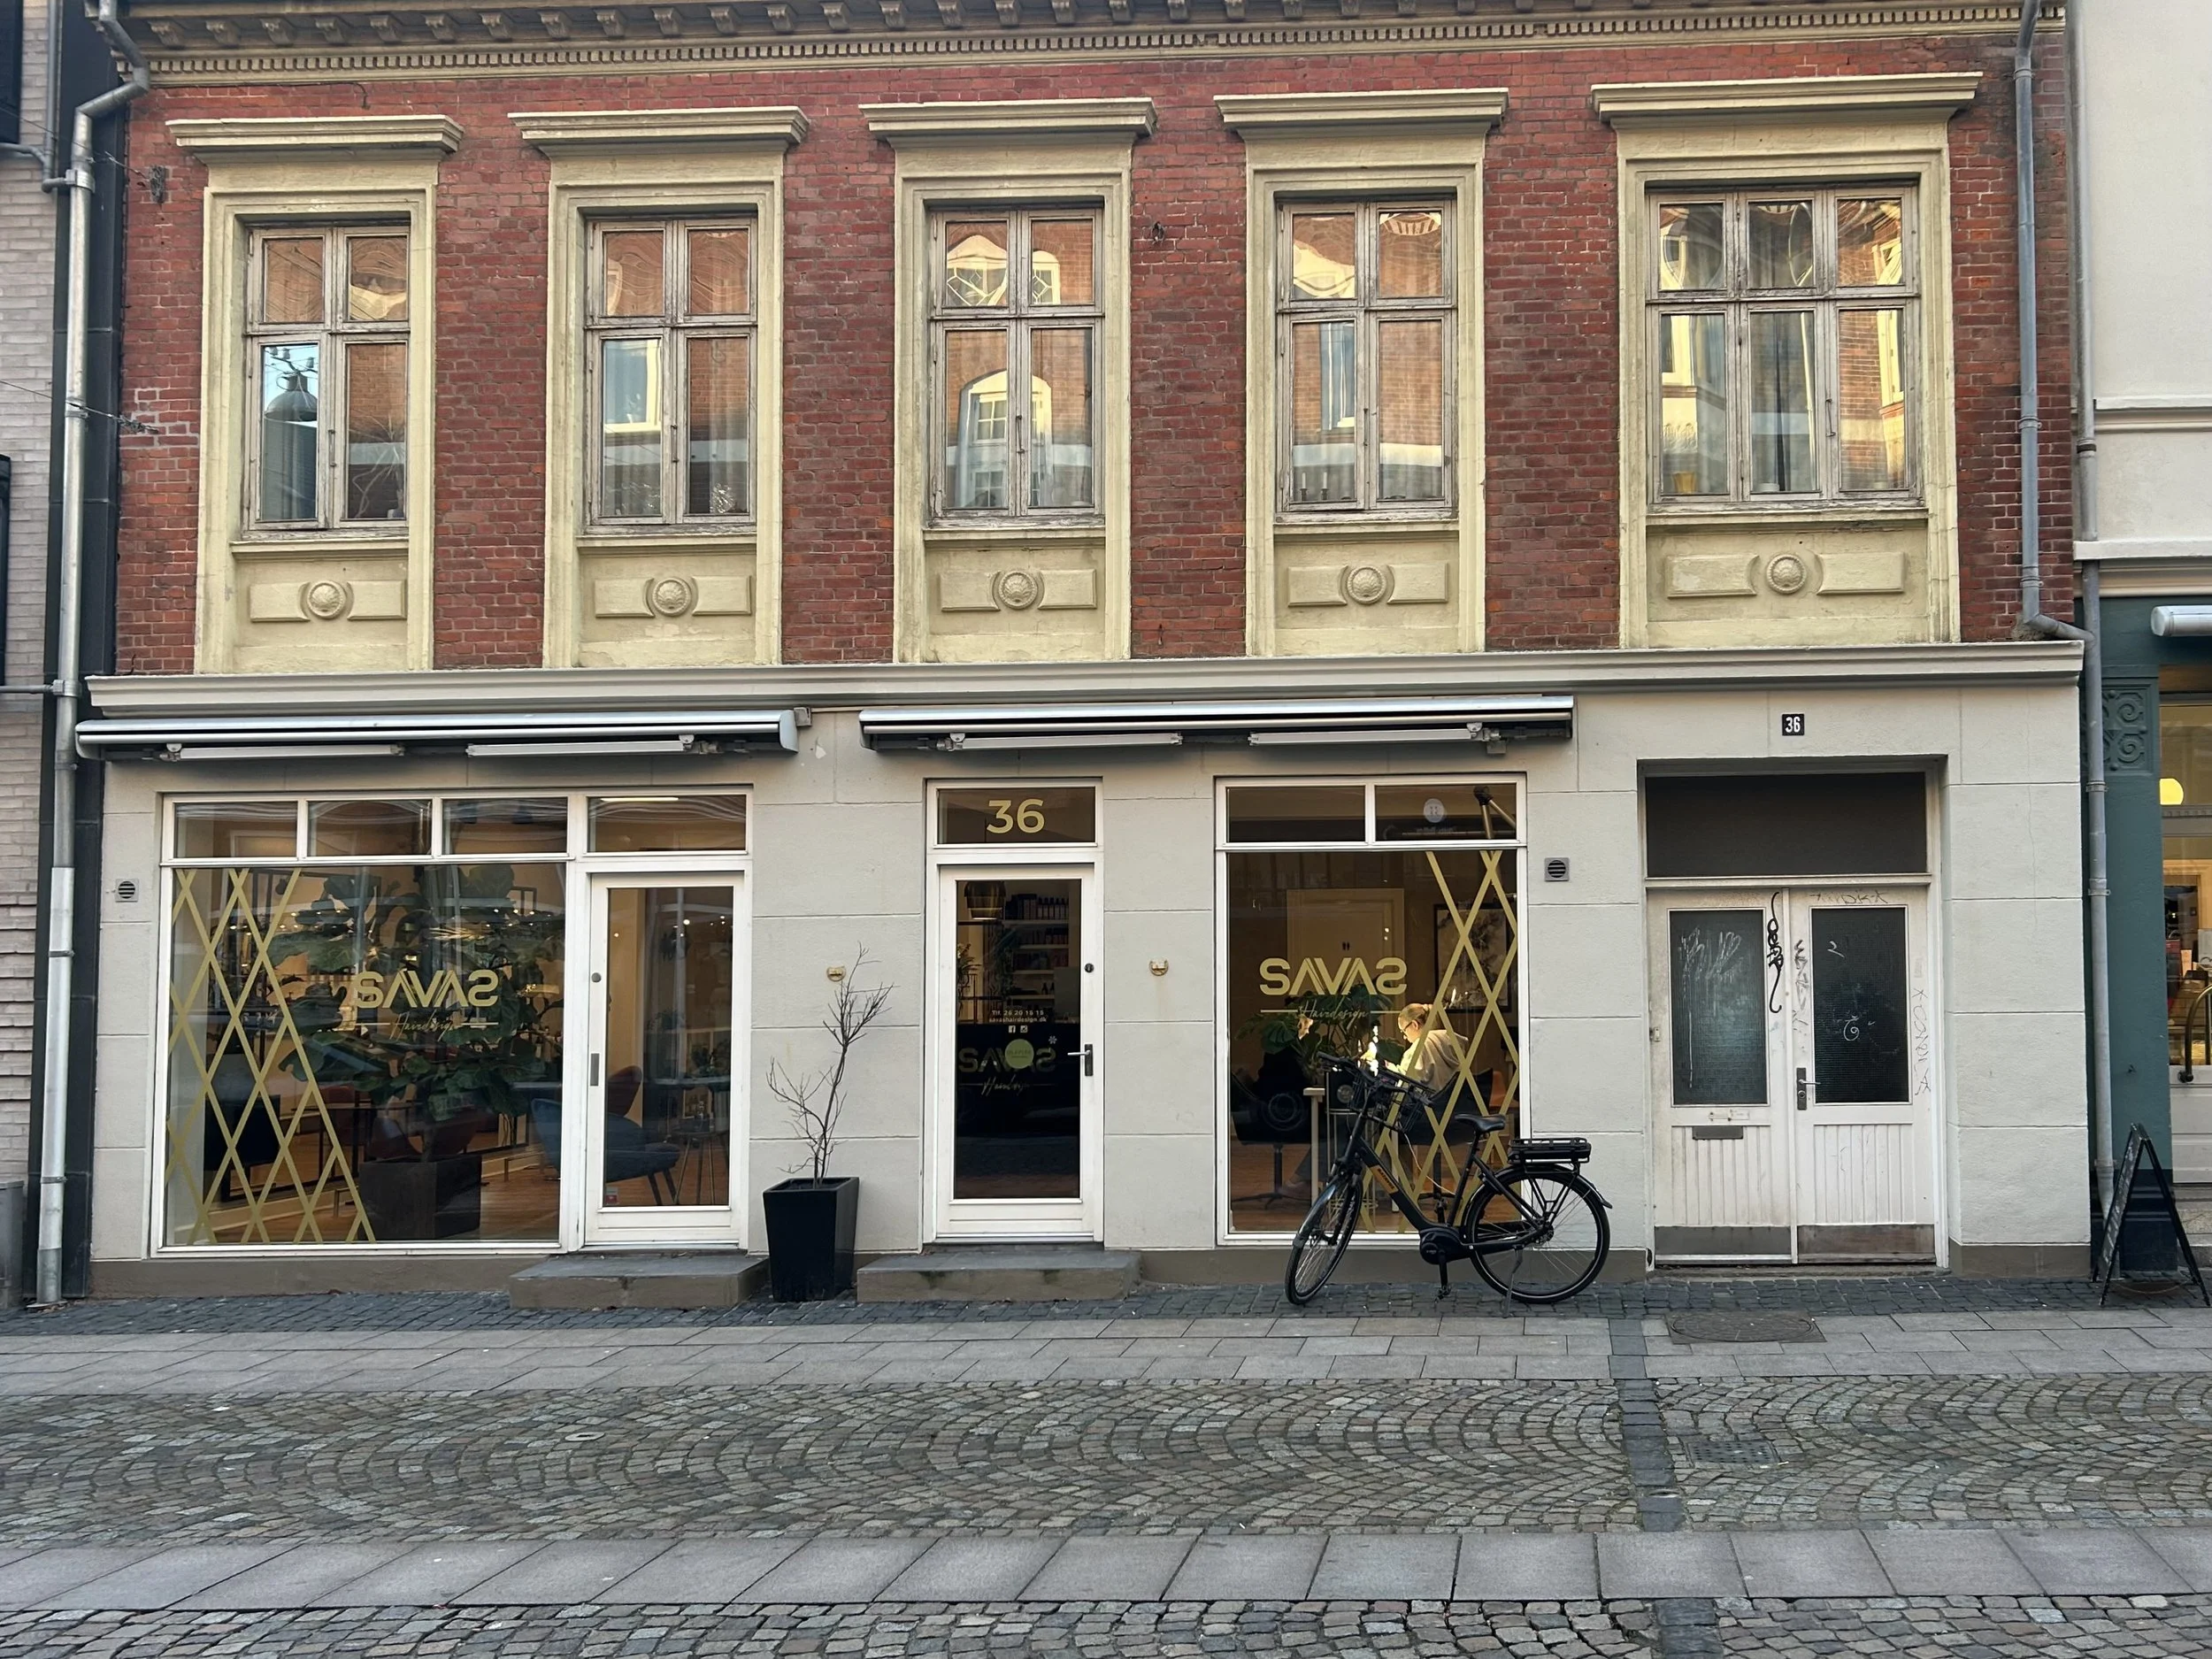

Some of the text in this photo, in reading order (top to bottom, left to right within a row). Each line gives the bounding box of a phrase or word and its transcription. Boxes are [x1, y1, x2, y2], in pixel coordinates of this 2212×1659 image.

[1785, 716, 1801, 733] 36
[987, 798, 1045, 833] 36
[356, 968, 499, 1009] SAVAS
[1259, 957, 1408, 996] SAVAS
[1298, 995, 1369, 1027] Hairdesign
